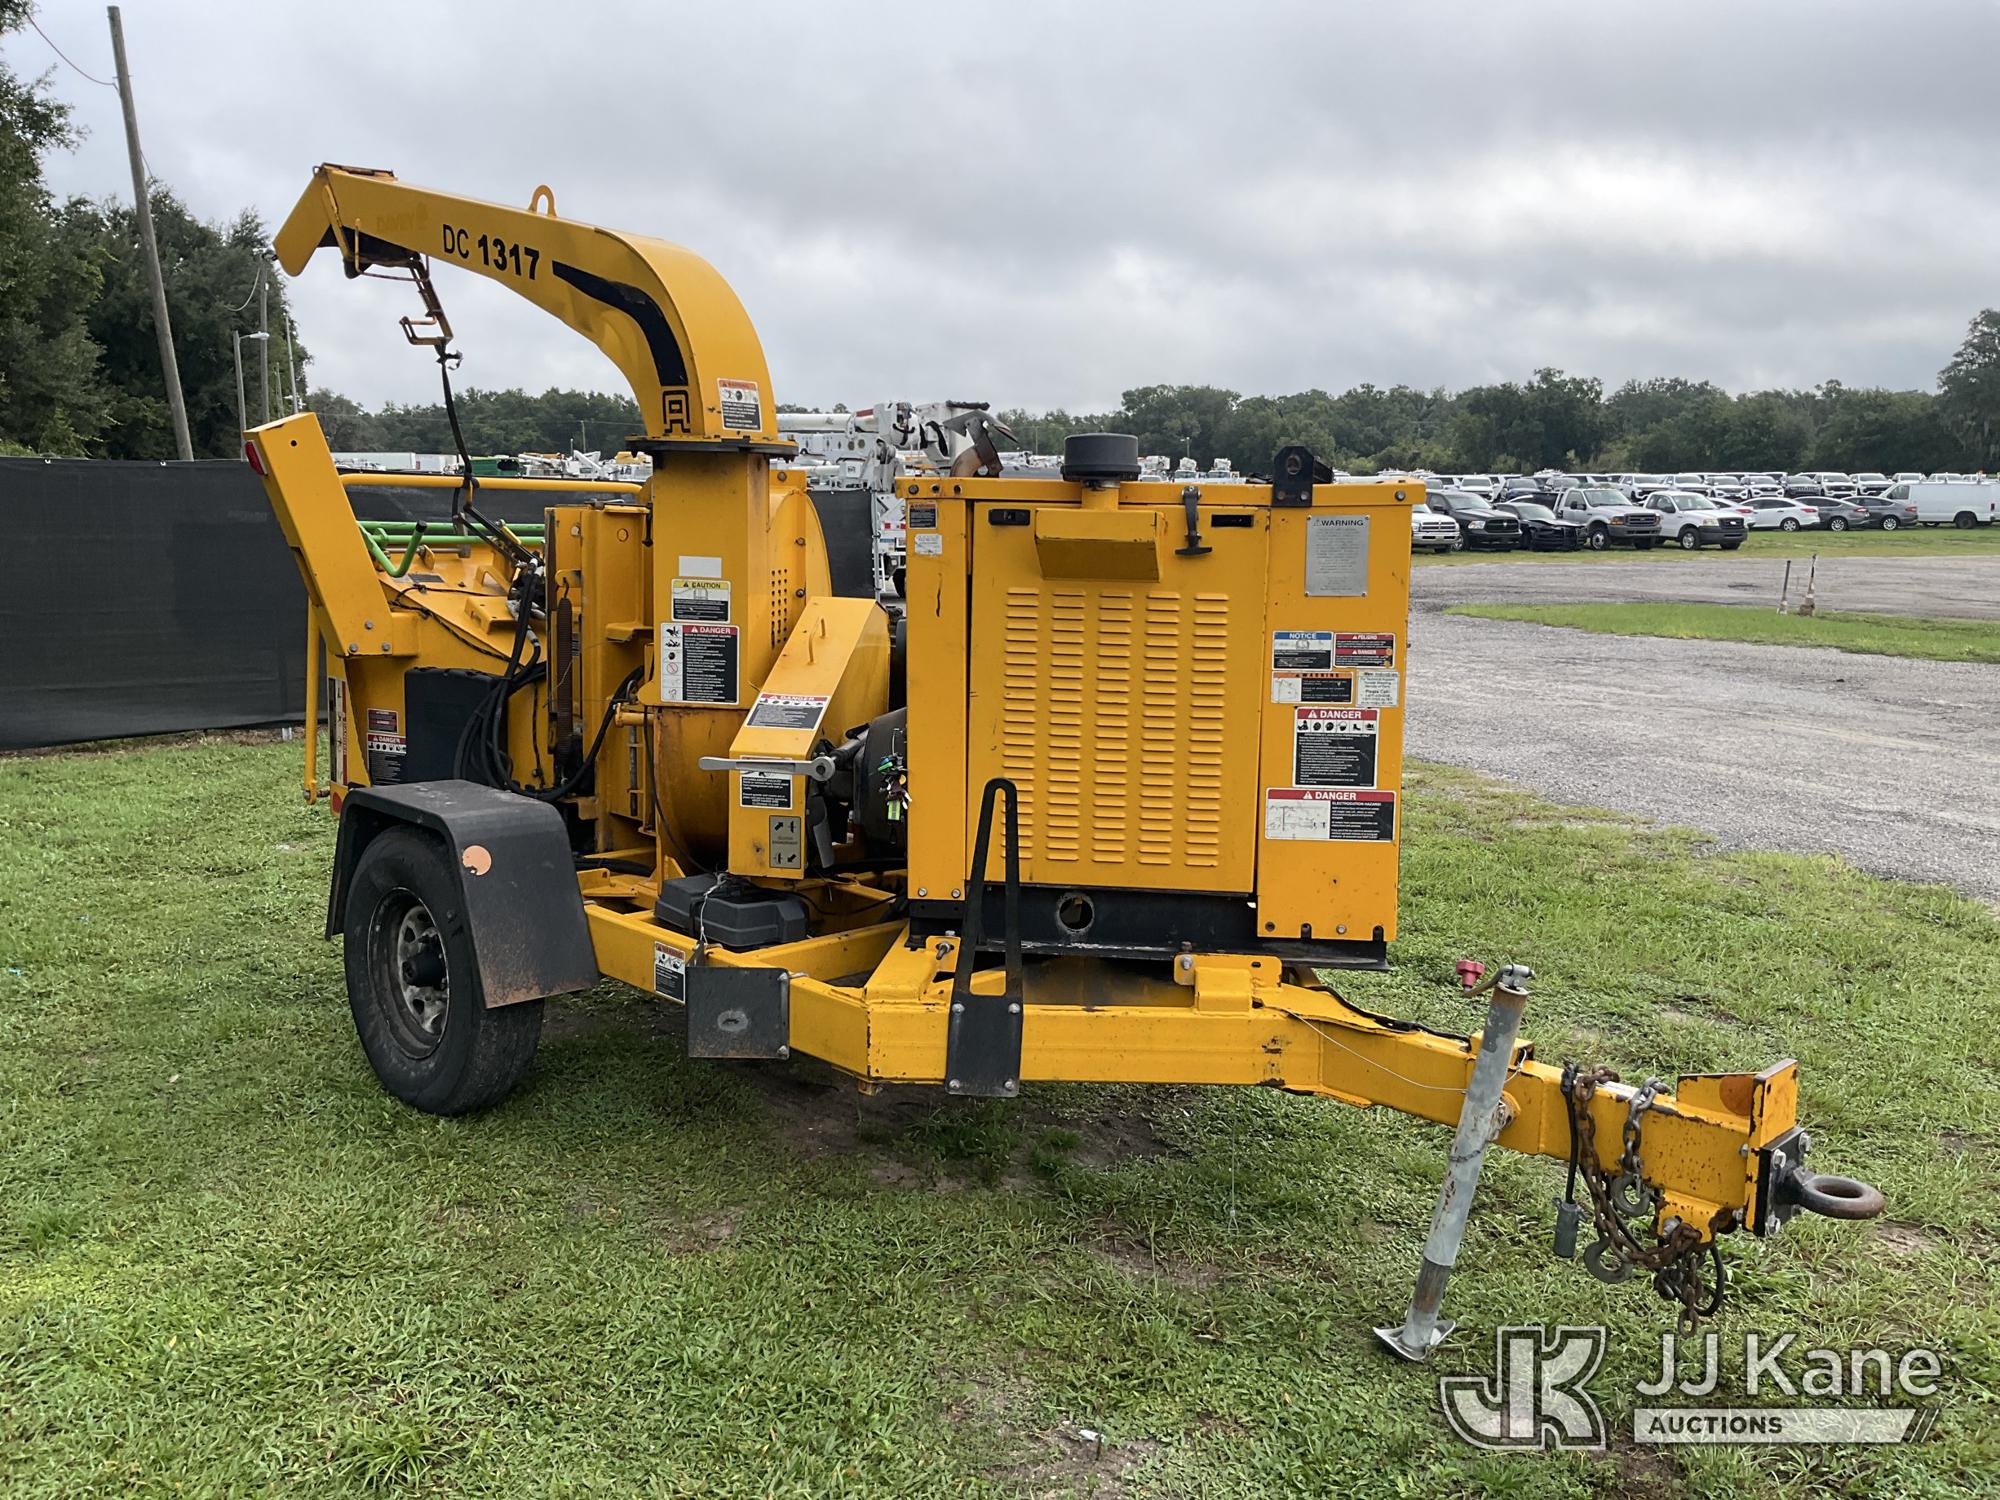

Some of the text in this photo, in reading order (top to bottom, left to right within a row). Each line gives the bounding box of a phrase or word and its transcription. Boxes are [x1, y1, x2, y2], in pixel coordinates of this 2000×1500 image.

[442, 223, 540, 280] DC 1317
[1321, 519, 1364, 527] WARNING
[692, 581, 721, 590] CAUTION
[699, 626, 731, 635] DANGER
[1319, 710, 1362, 719] DANGER
[1315, 791, 1357, 801] DANGER
